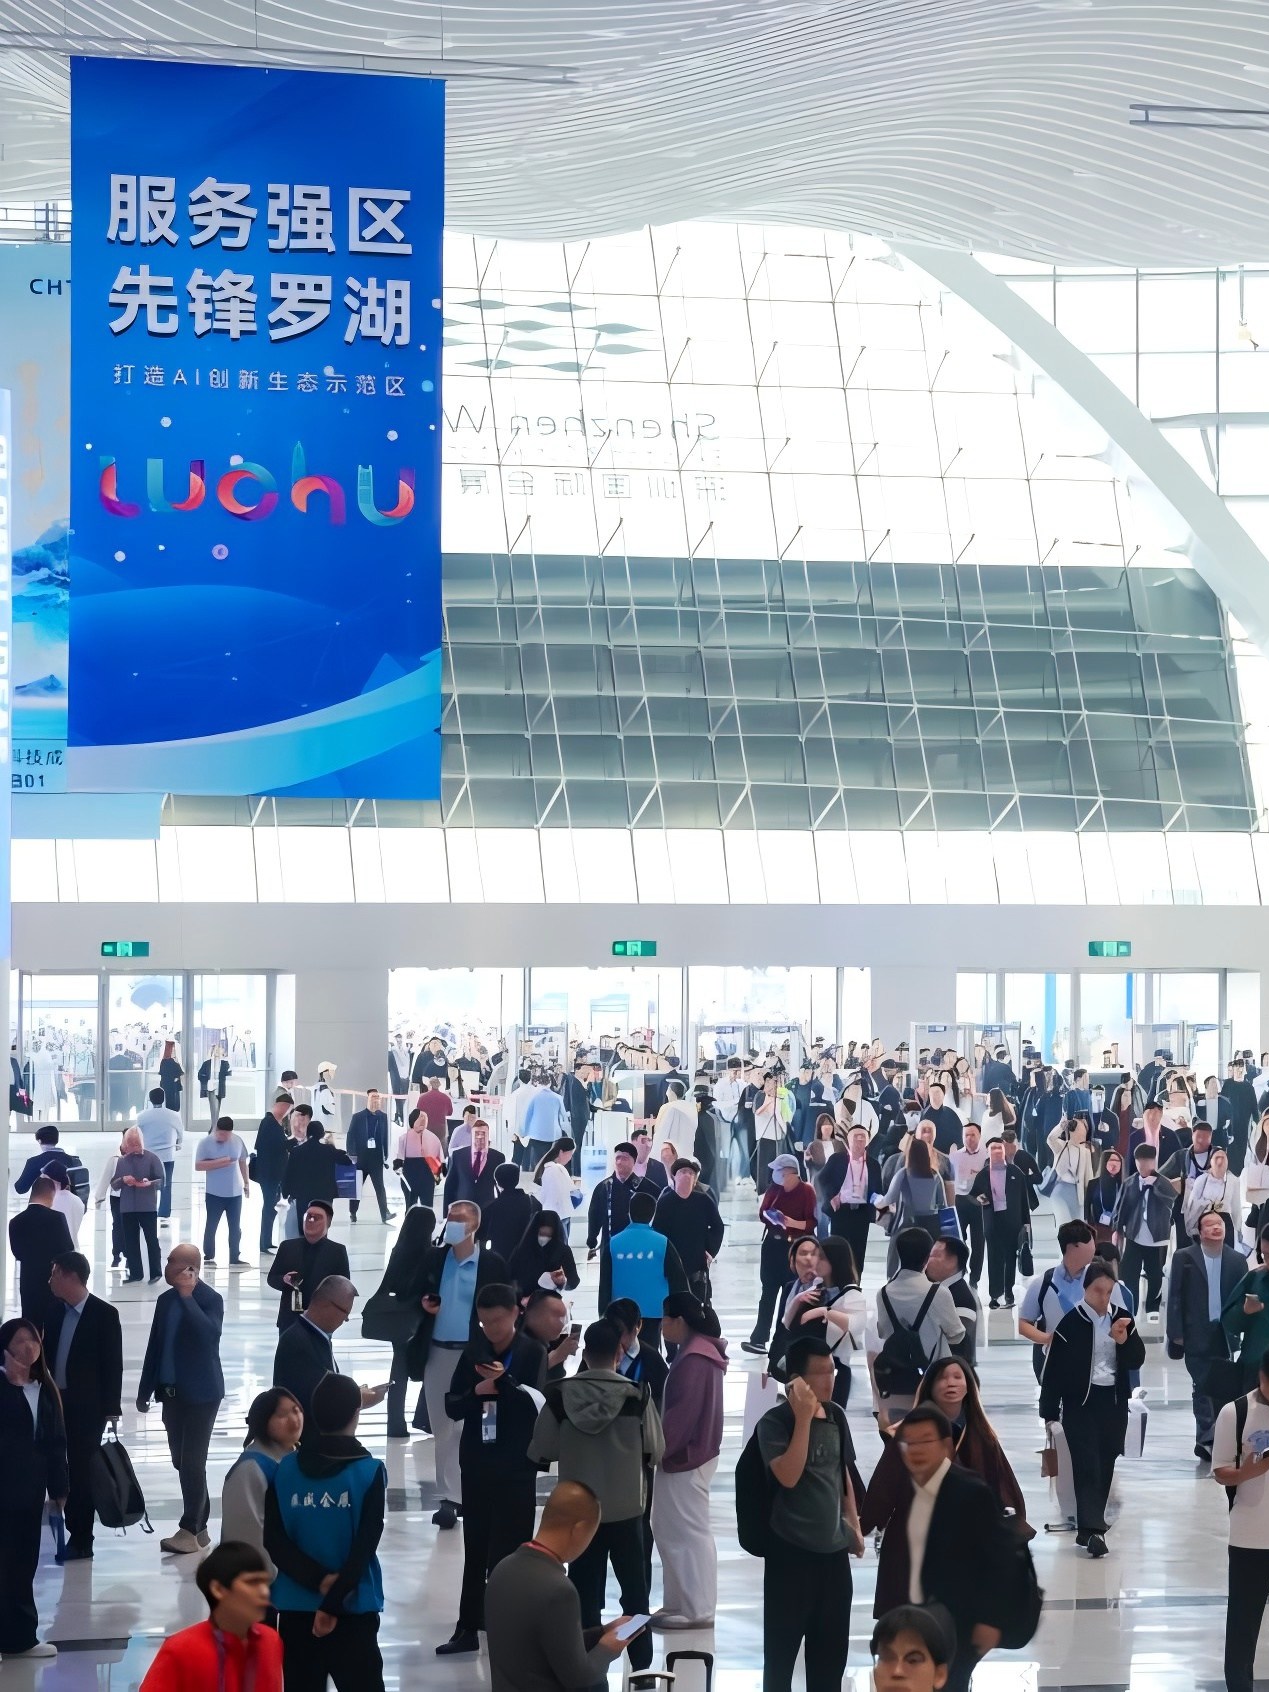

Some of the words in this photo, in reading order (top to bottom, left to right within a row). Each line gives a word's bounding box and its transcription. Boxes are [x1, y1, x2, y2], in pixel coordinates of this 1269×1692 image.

[107, 173, 413, 255] 服务强区
[108, 264, 411, 346] 先锋罗湖
[113, 364, 406, 396] 打造AI创新生态示范区
